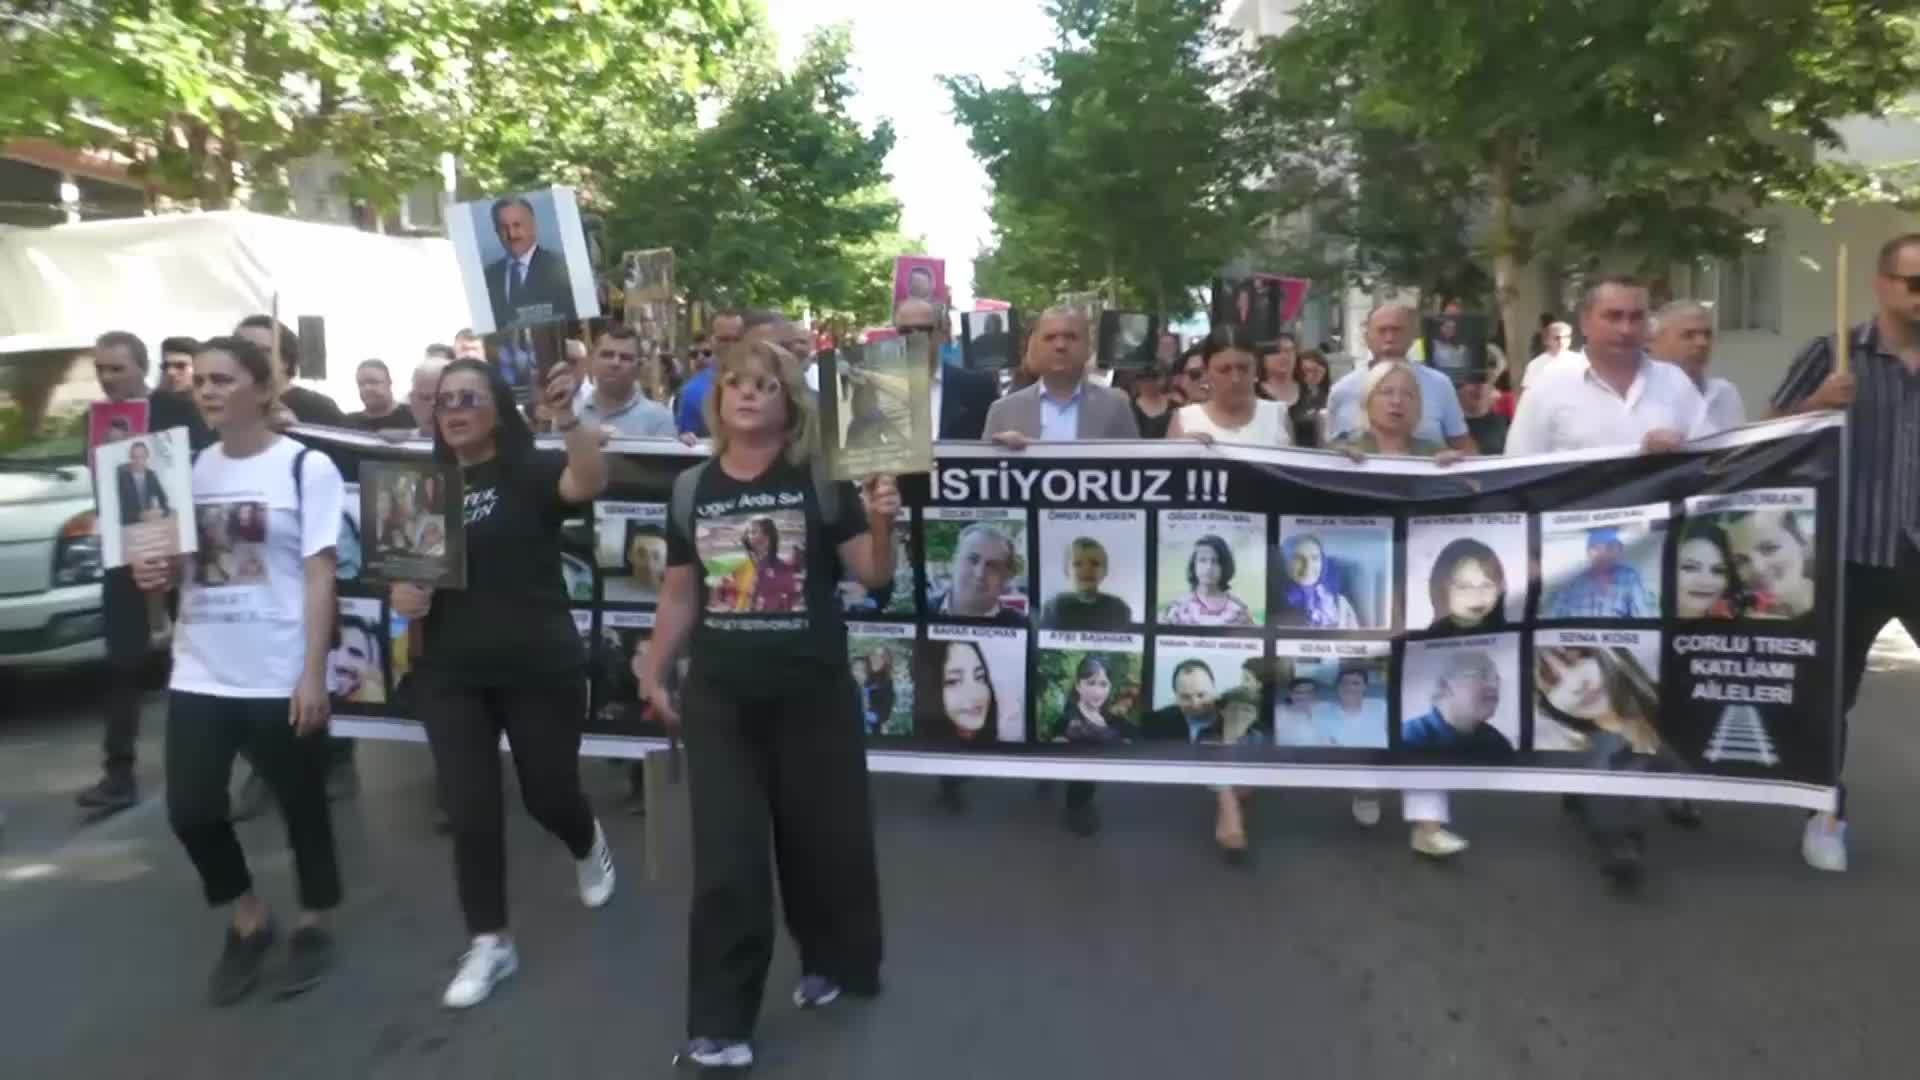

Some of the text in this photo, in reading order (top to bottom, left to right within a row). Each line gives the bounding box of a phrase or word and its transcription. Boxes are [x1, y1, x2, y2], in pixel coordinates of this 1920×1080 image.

[930, 461, 1171, 502] İSTİYORUZ
[738, 493, 777, 508] Arda
[1671, 634, 1817, 656] ÇORLU TREN
[1691, 680, 1794, 704] AİLELERİ
